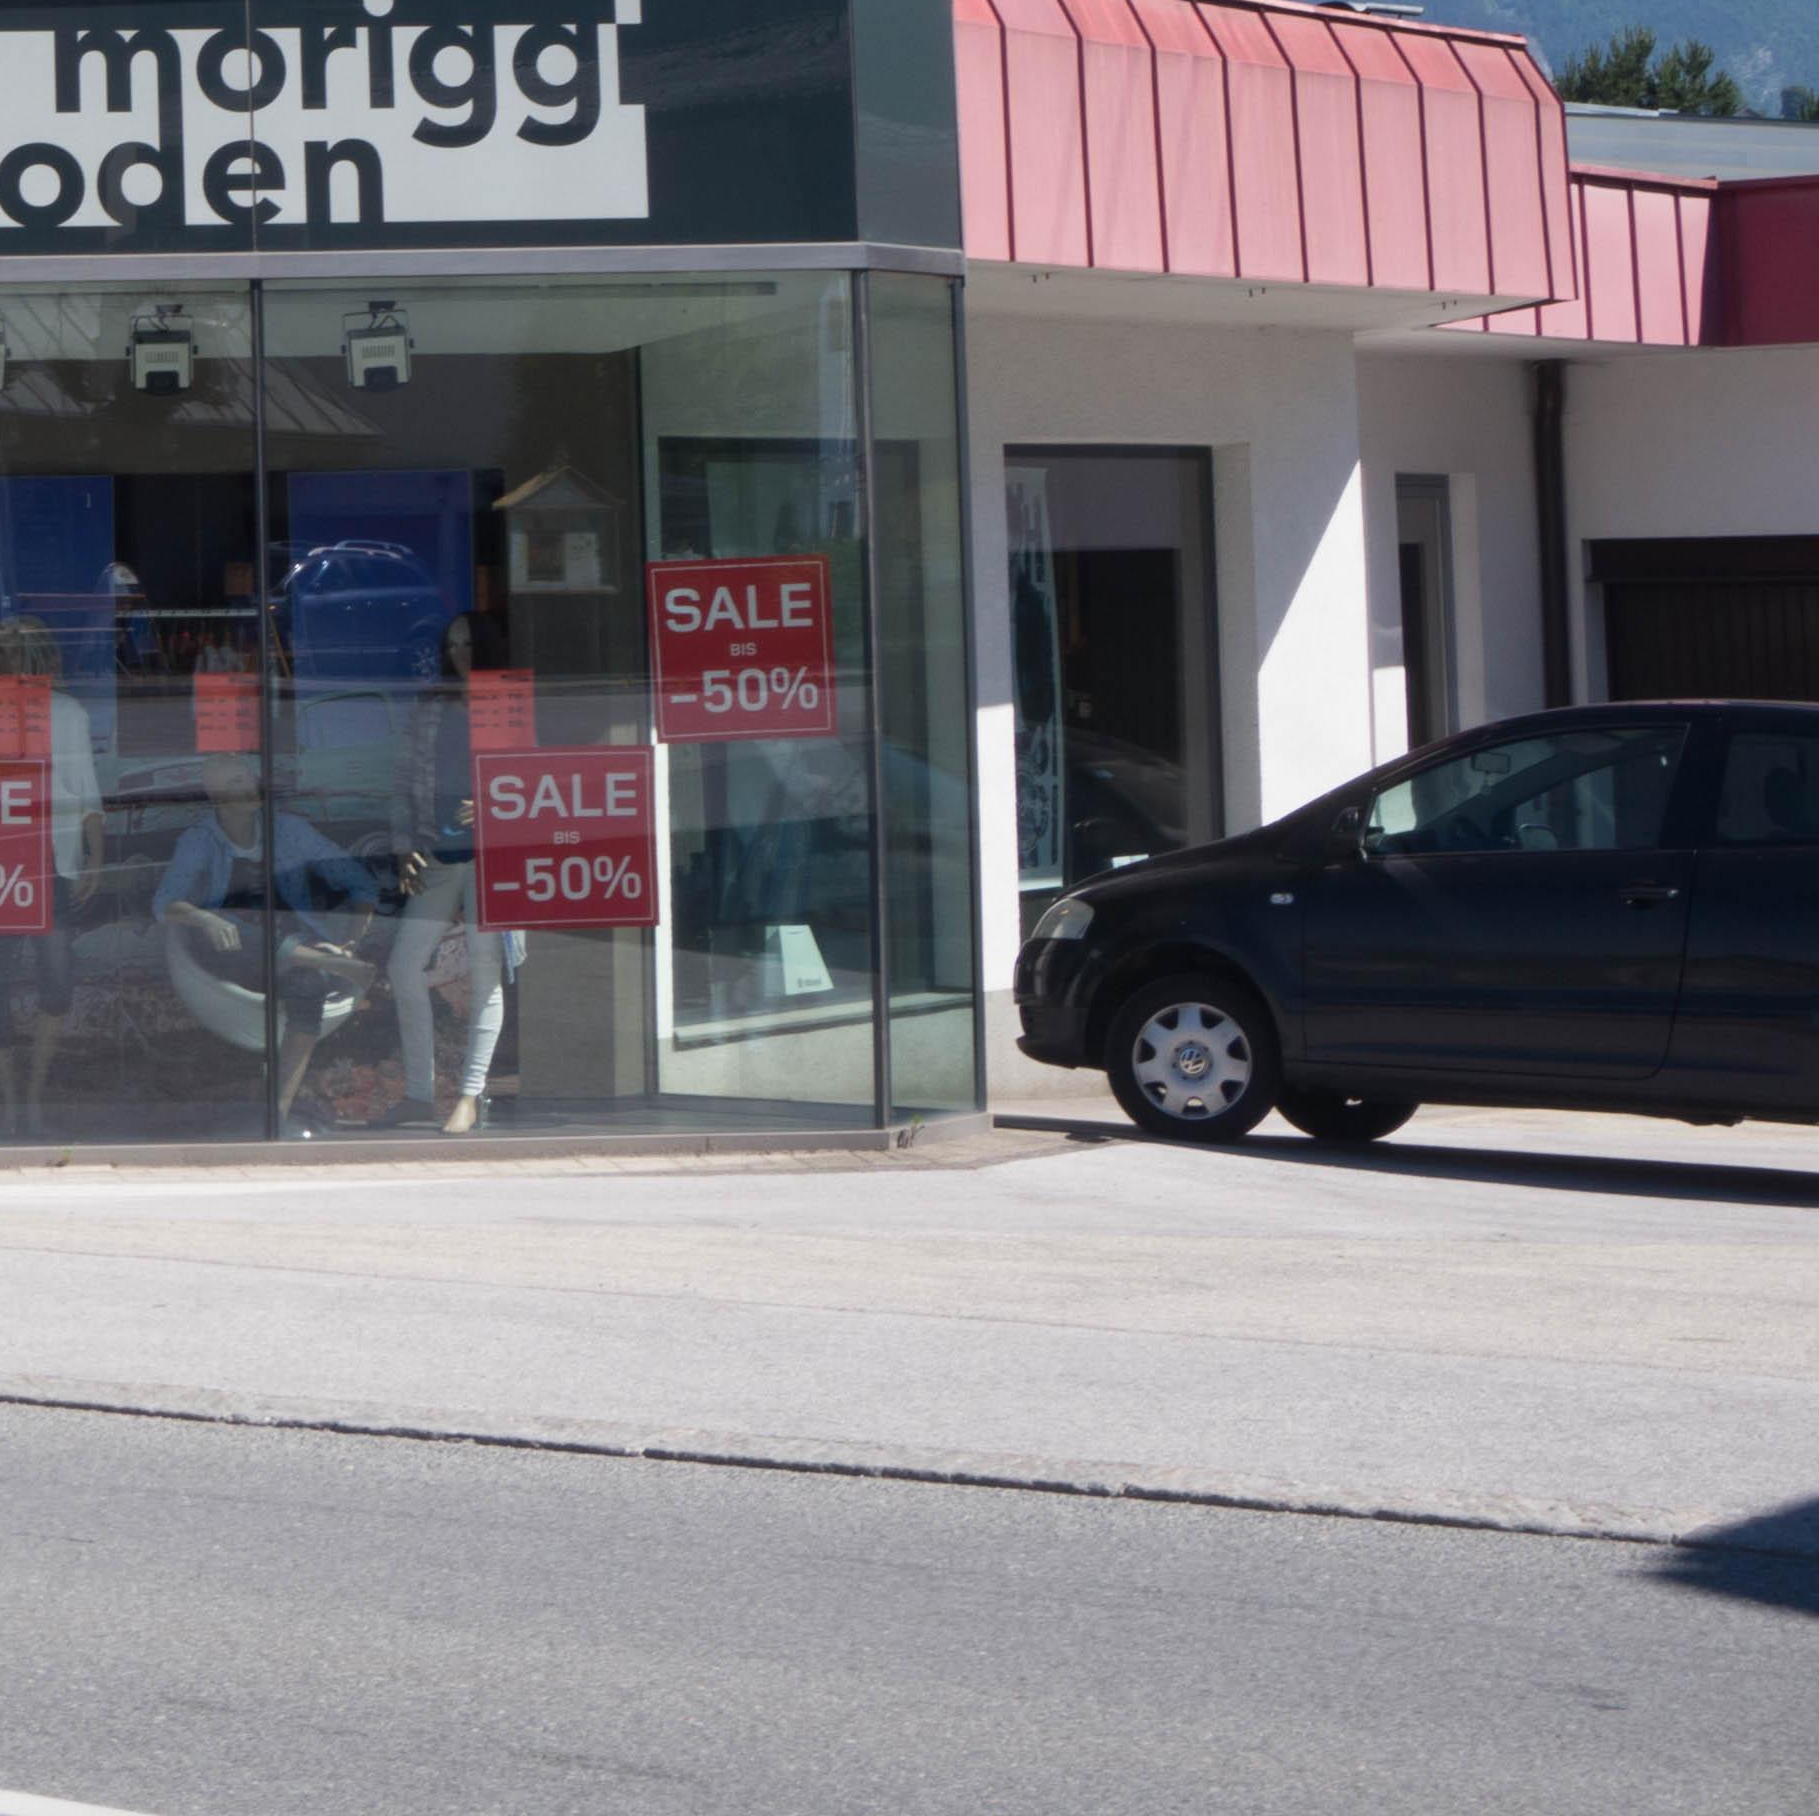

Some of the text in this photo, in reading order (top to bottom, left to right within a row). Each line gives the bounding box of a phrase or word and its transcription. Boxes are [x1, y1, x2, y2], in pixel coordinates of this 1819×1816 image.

[665, 582, 813, 633] SALE
[730, 642, 758, 657] BIS
[670, 666, 819, 713] -50%
[489, 772, 638, 820] SALE
[553, 831, 580, 845] BIS
[493, 855, 642, 902] -50%
